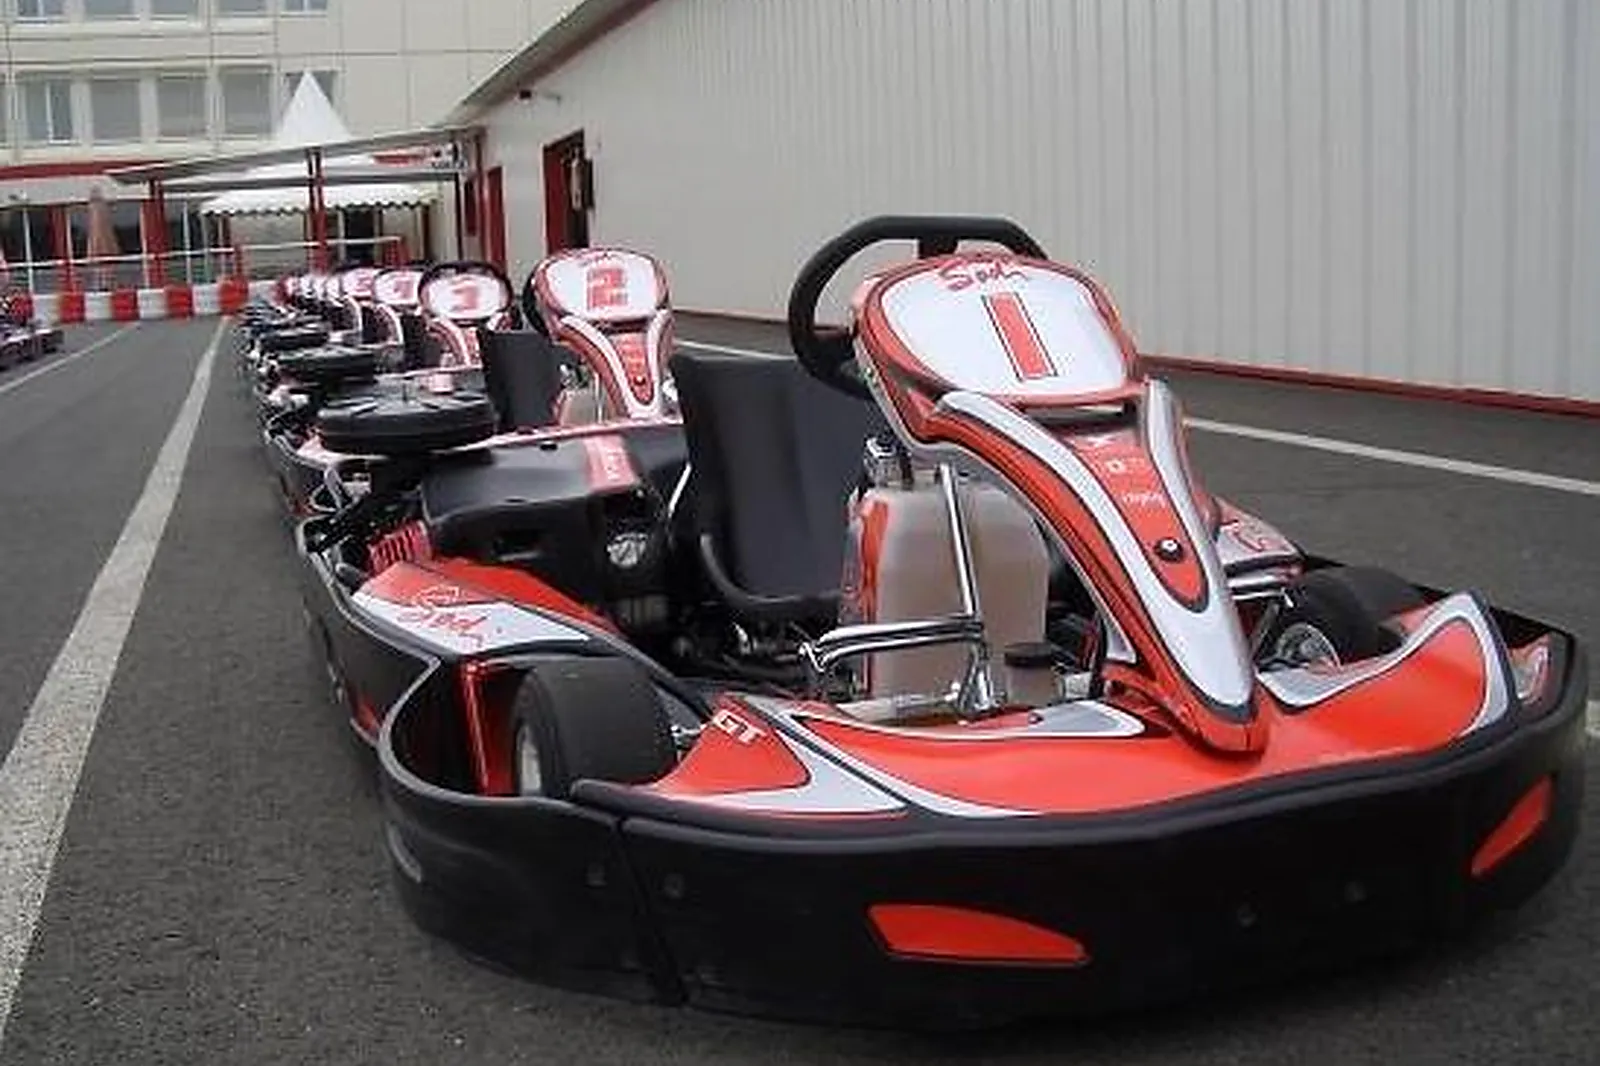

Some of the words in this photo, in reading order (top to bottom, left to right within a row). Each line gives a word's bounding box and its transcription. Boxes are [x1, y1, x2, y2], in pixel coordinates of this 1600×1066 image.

[586, 265, 629, 310] 2
[980, 290, 1059, 383] 1
[712, 709, 768, 744] GT
